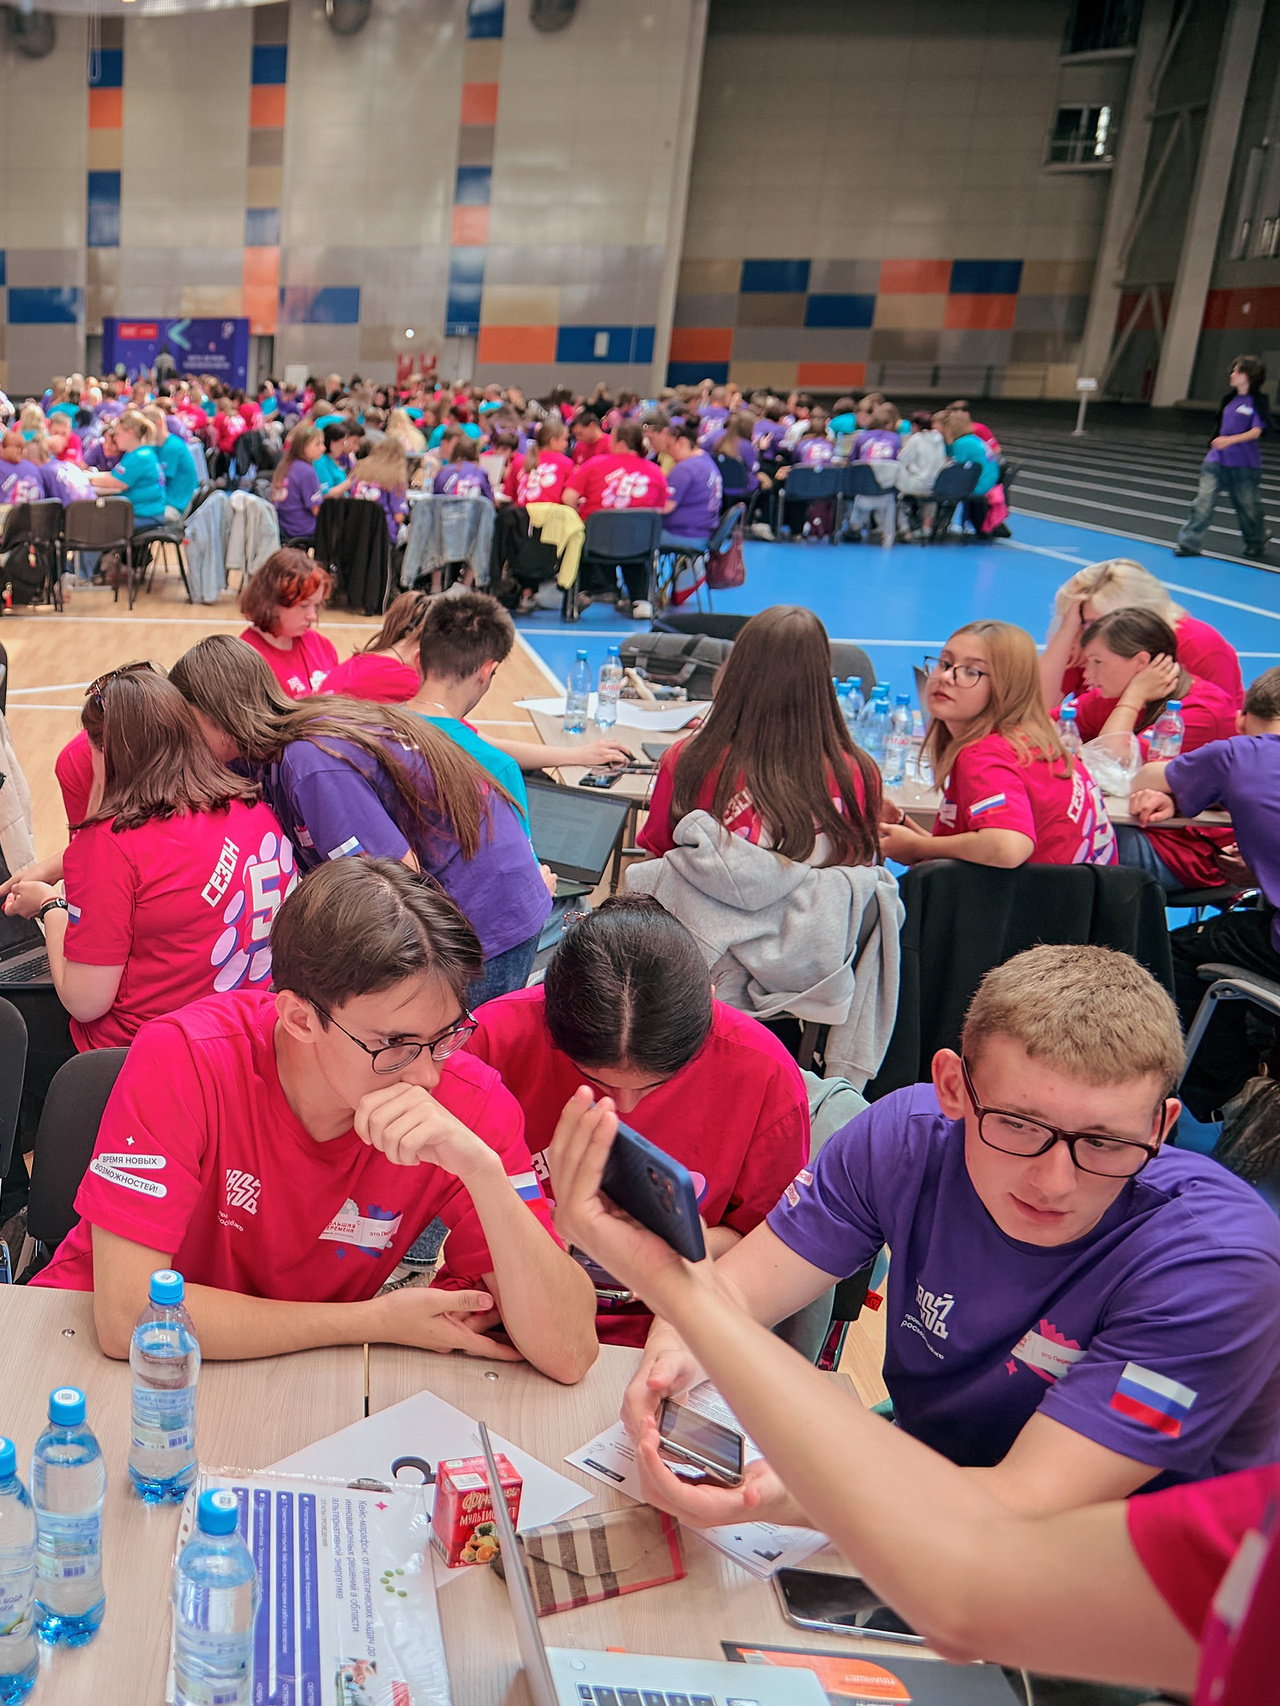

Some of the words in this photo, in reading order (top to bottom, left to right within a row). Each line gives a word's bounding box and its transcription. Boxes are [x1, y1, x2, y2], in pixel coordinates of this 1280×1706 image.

[200, 836, 240, 908] СЕЗОН
[248, 859, 282, 942] 5
[94, 1163, 158, 1193] ВОЗМОЖНОСТЕЙ!
[102, 1155, 123, 1163] ВРЕМЯ
[125, 1156, 157, 1165] НОВЫХ
[331, 1497, 343, 1555] альтернативной
[345, 1499, 355, 1555] инновационных
[358, 1499, 370, 1555] Кейс-марафон:
[333, 1557, 343, 1599] энергетике
[346, 1556, 359, 1590] решений
[361, 1556, 370, 1566] от
[360, 1567, 375, 1618] практических
[350, 1599, 361, 1632] области
[366, 1645, 376, 1657] до
[844, 1673, 896, 1685] ПЛАНШЕТ
